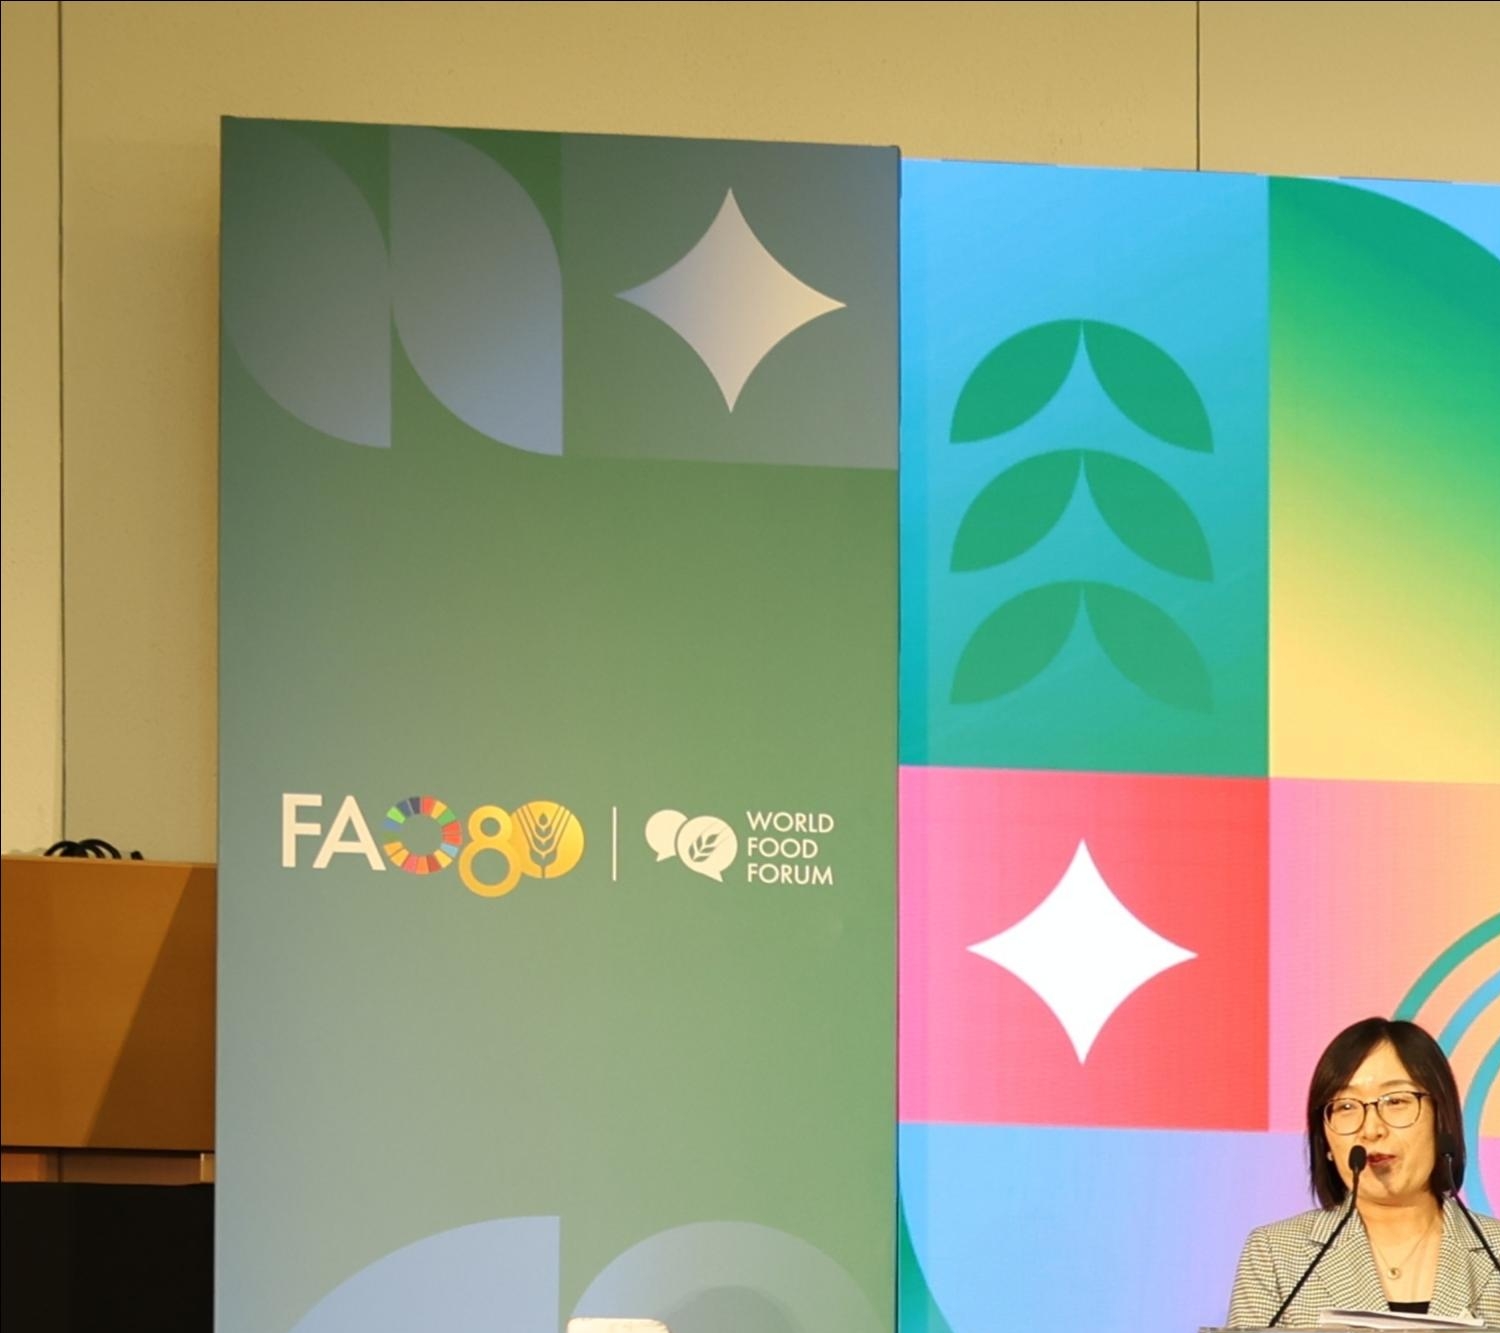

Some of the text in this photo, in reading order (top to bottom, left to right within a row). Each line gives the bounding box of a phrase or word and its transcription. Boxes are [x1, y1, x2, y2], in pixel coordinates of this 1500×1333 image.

[746, 811, 835, 834] WORLD
[746, 837, 819, 858] FOOD
[746, 862, 835, 886] FORUM
